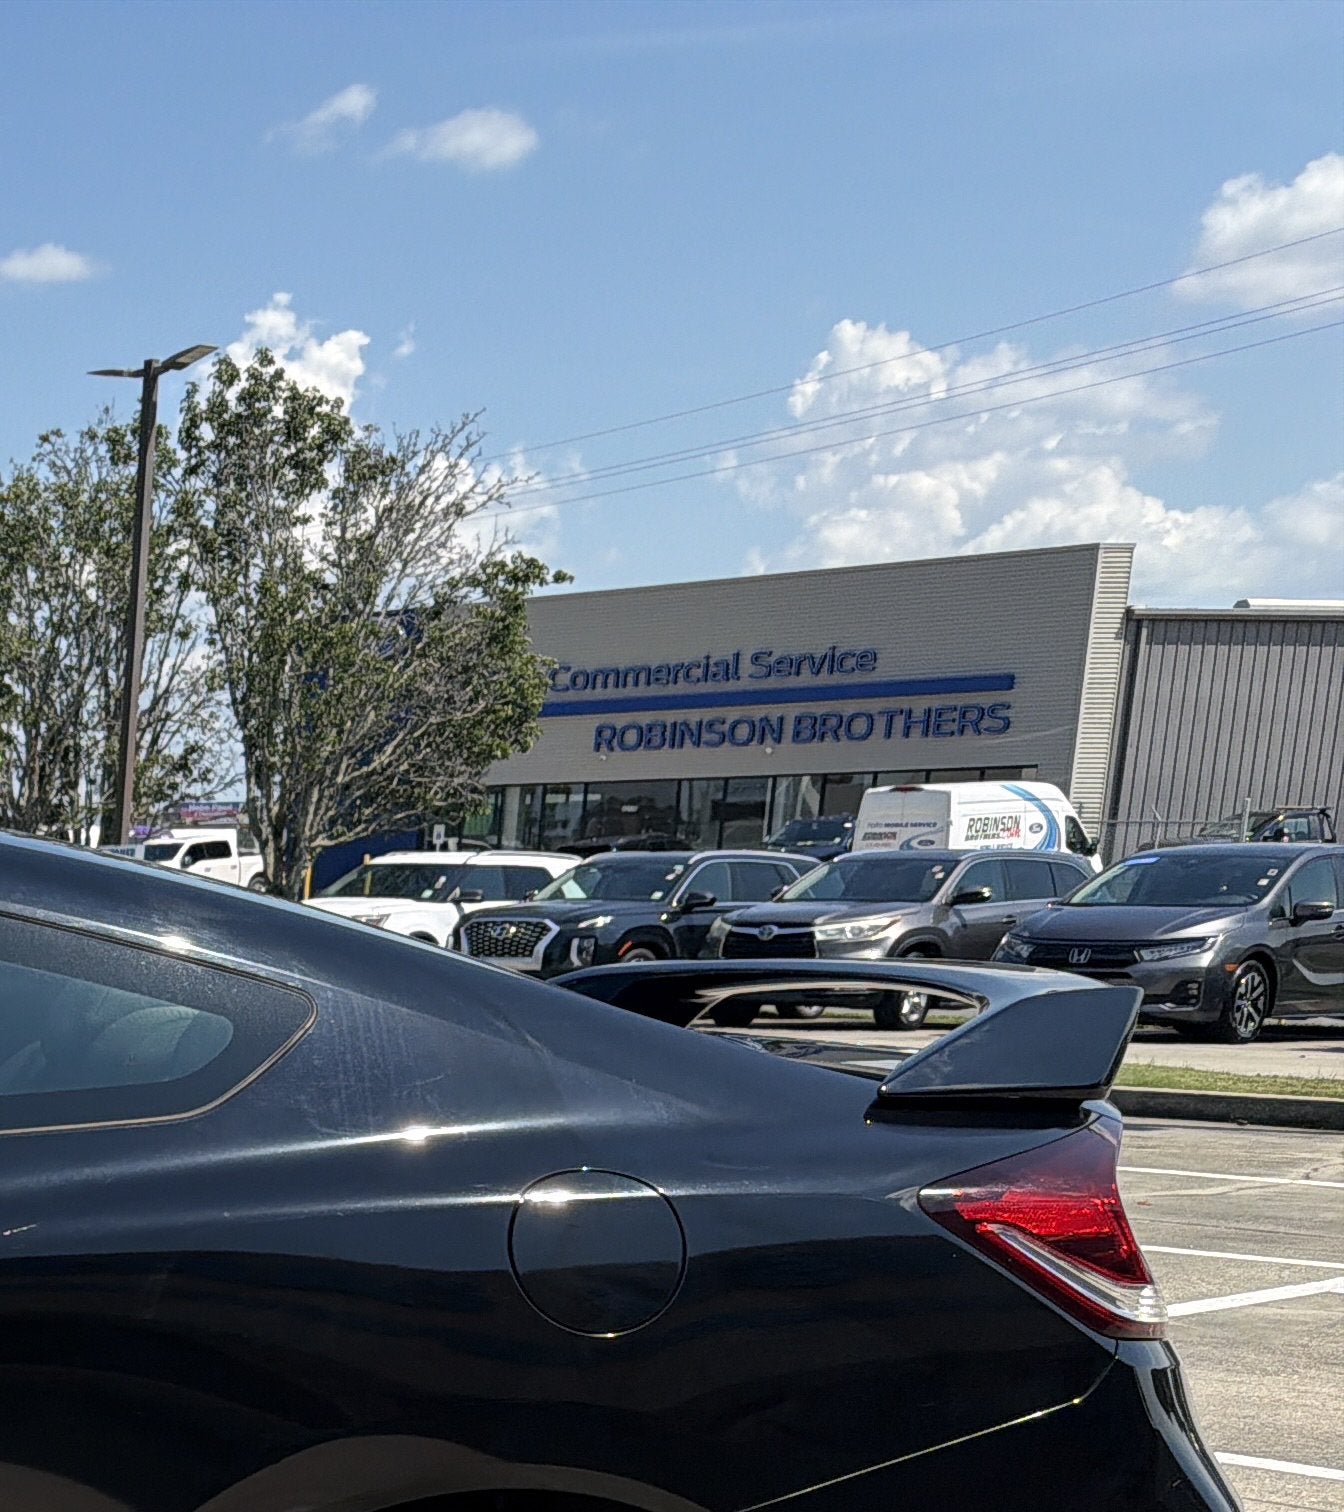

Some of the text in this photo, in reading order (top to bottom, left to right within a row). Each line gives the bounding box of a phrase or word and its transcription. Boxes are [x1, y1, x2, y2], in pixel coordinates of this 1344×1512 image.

[548, 645, 878, 692] Commercial Service
[593, 702, 1012, 753] ROBINSON BROTHERS
[965, 814, 1021, 835] ROBINSON
